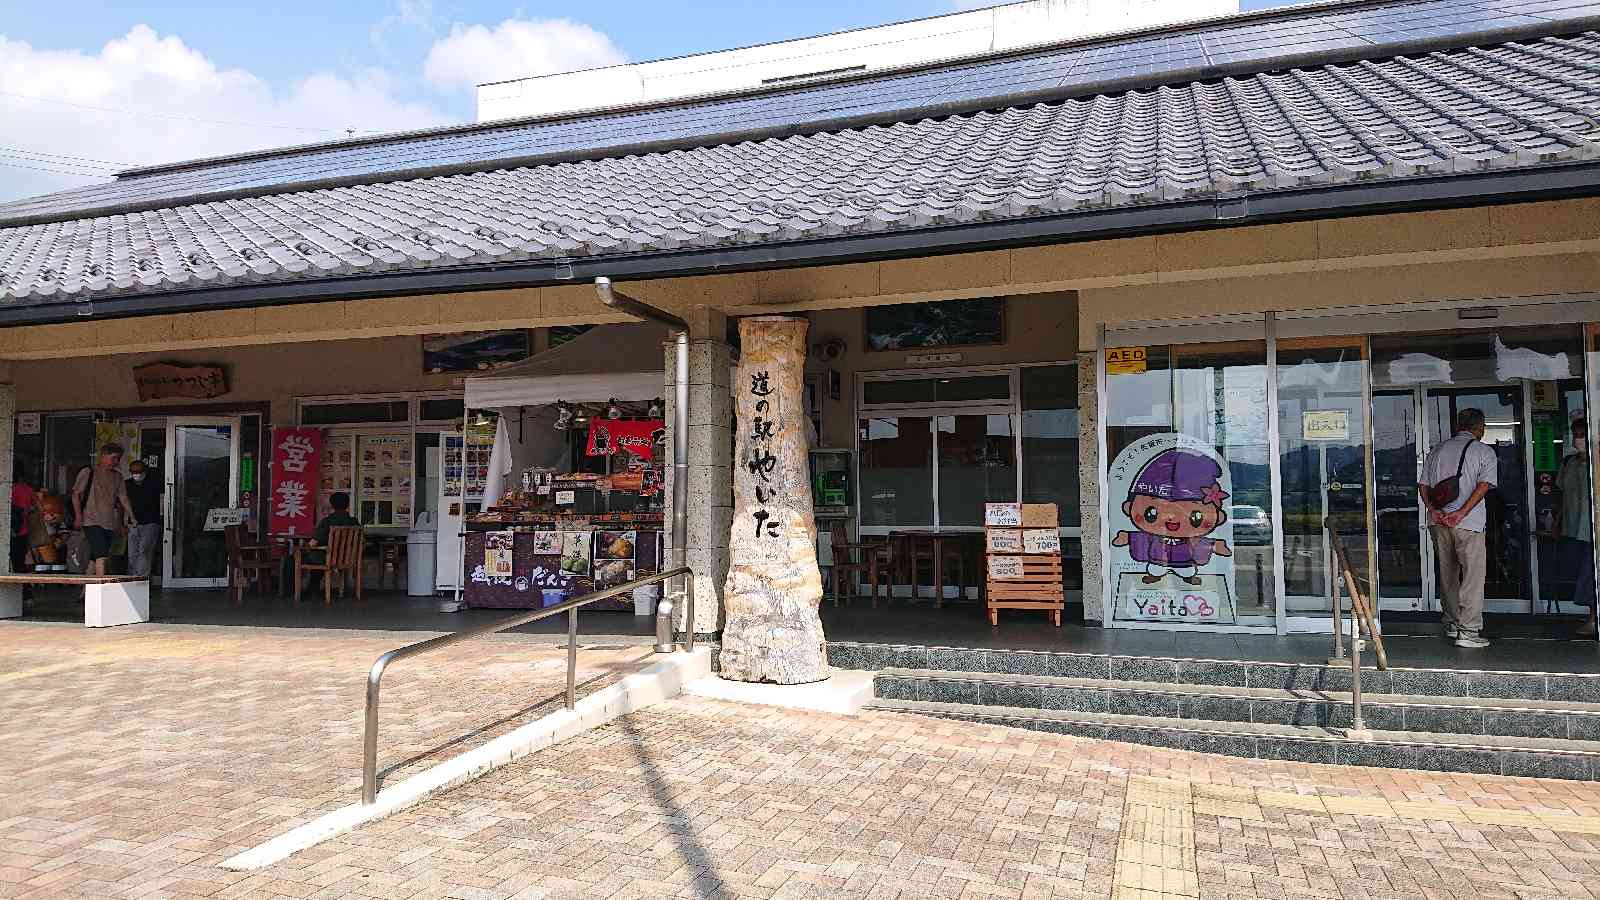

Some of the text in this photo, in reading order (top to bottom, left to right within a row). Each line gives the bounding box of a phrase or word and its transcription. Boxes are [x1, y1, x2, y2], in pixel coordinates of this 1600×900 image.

[1108, 350, 1145, 361] AED
[273, 434, 315, 536] 営業
[1138, 482, 1168, 495] やいた
[1134, 598, 1188, 617] Yaita
